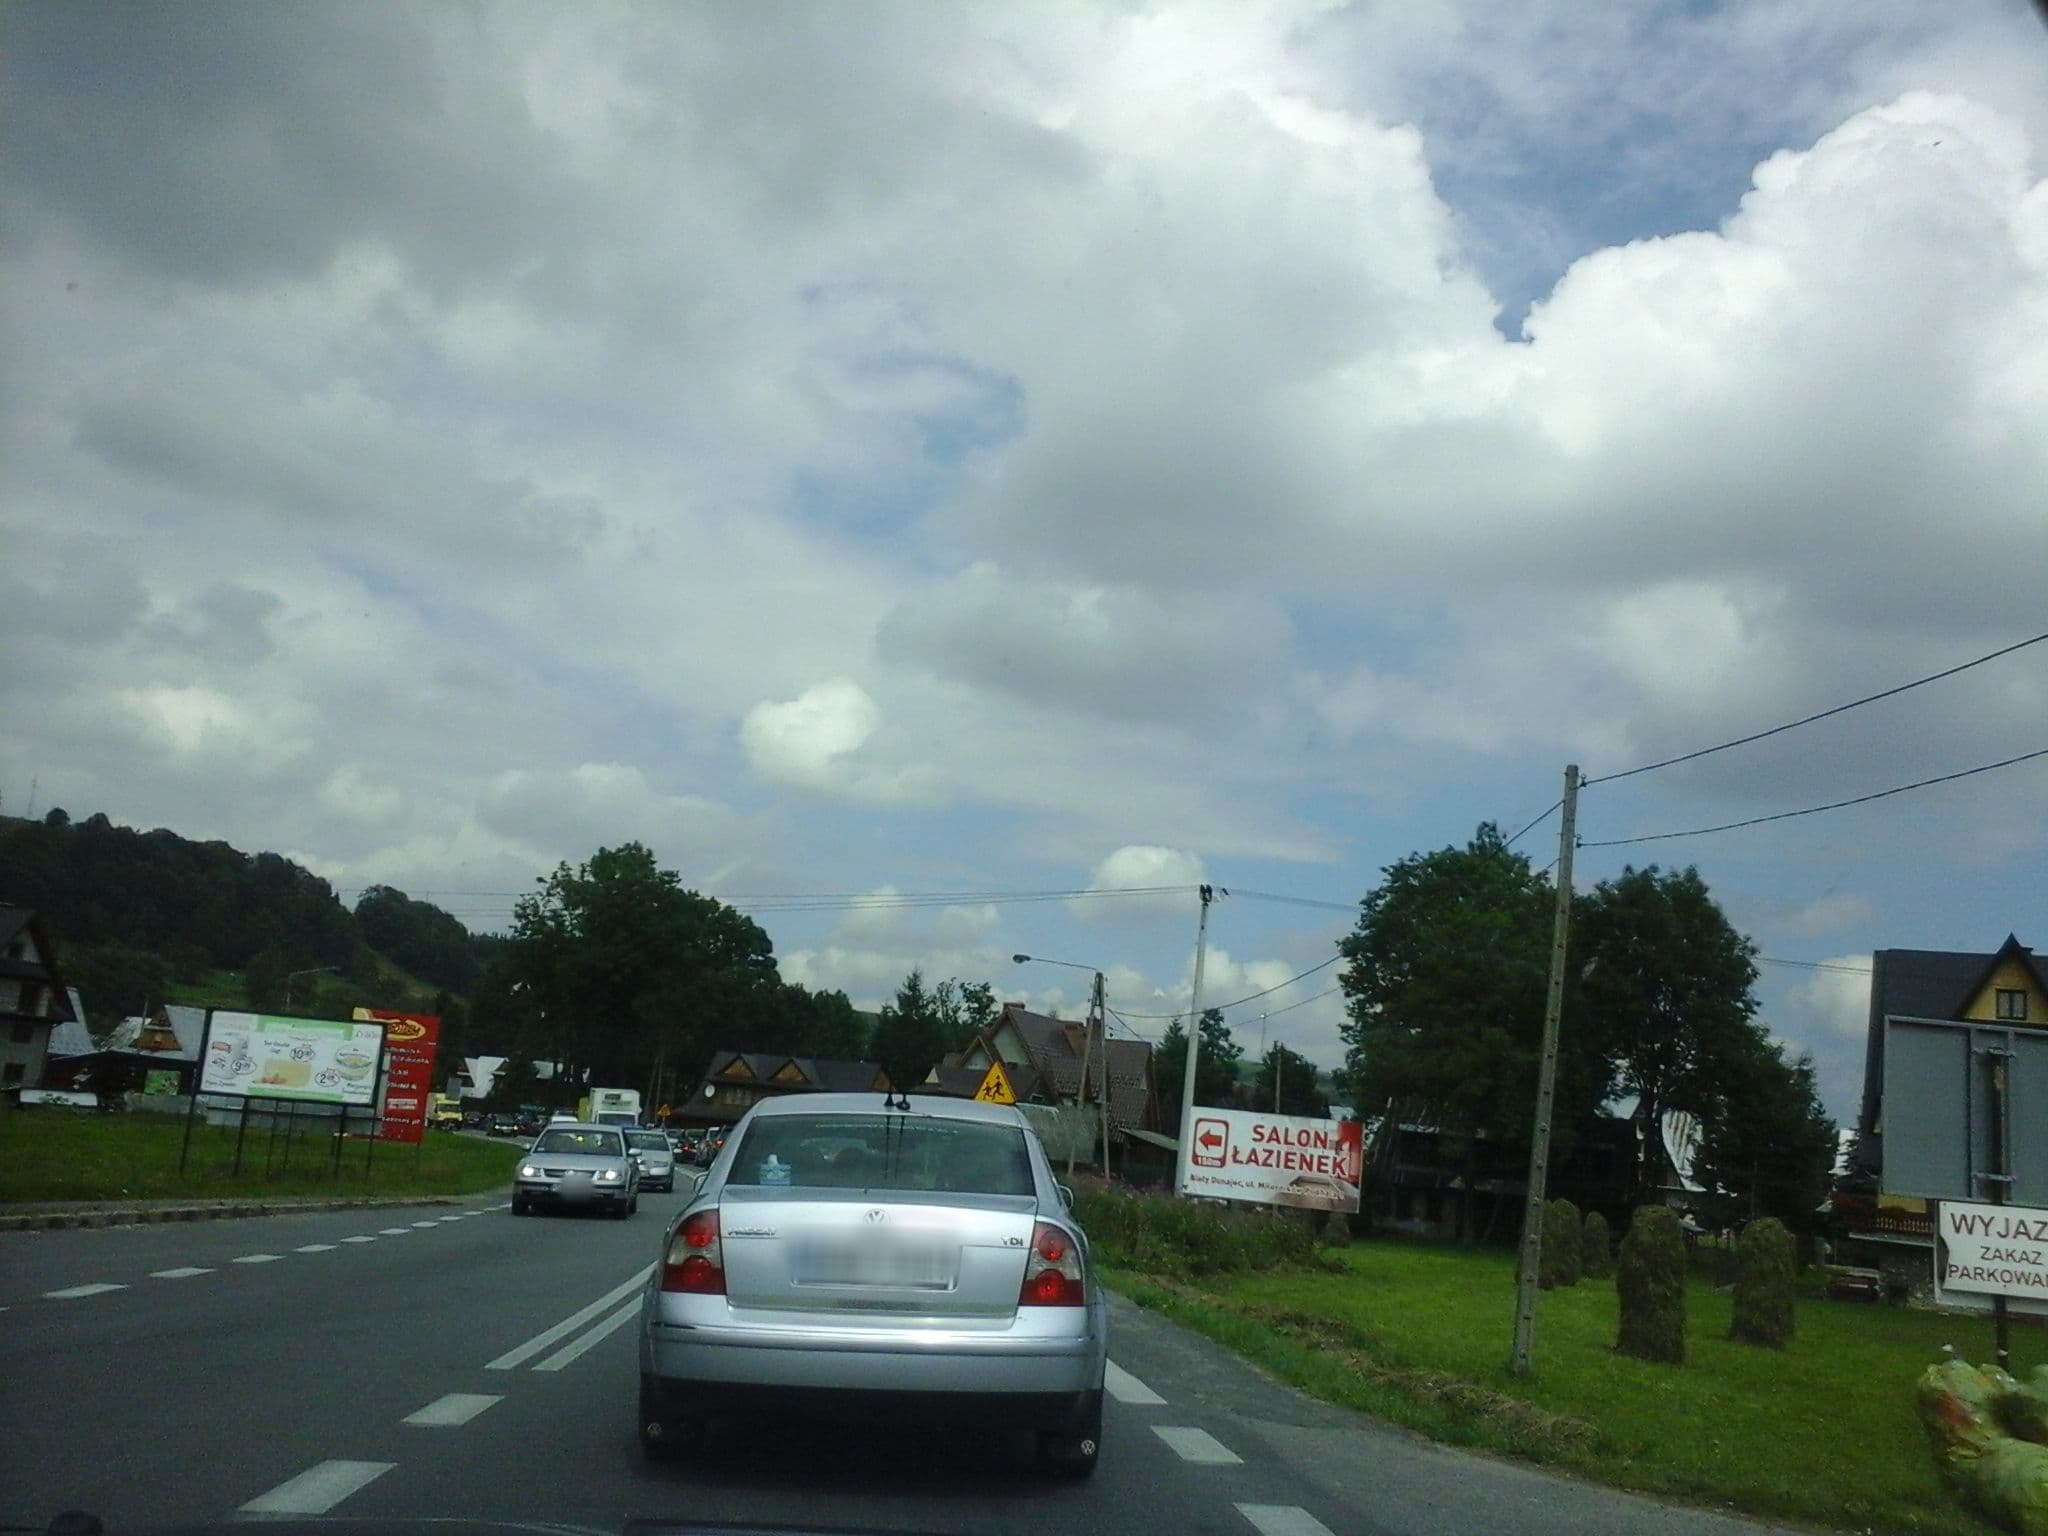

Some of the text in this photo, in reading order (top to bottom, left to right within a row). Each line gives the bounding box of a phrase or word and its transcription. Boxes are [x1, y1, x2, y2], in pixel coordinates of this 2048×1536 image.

[1251, 1124, 1329, 1150] SALON
[1231, 1145, 1349, 1178] ŁAZIENEK
[1980, 1245, 2044, 1266] ZAKAZ
[1948, 1263, 2048, 1288] PARKOWA
